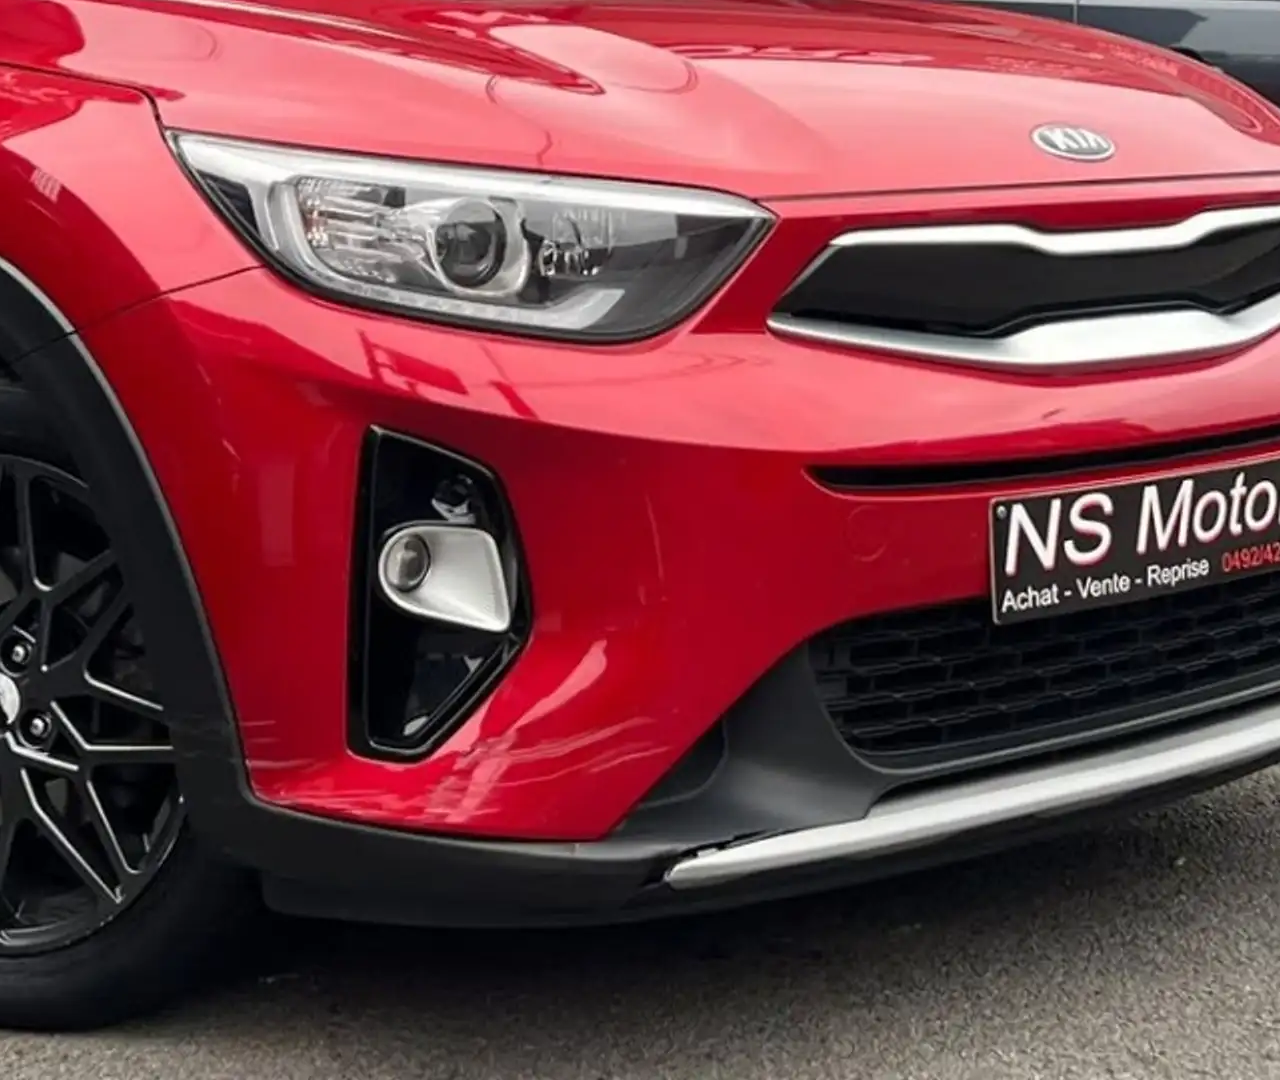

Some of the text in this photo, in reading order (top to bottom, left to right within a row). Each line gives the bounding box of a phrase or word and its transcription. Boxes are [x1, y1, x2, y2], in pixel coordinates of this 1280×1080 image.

[1042, 126, 1110, 151] KIA
[1004, 492, 1114, 576] NS
[1001, 588, 1060, 614] Achat
[1075, 575, 1132, 599] Vente
[1146, 557, 1210, 589] Reprise
